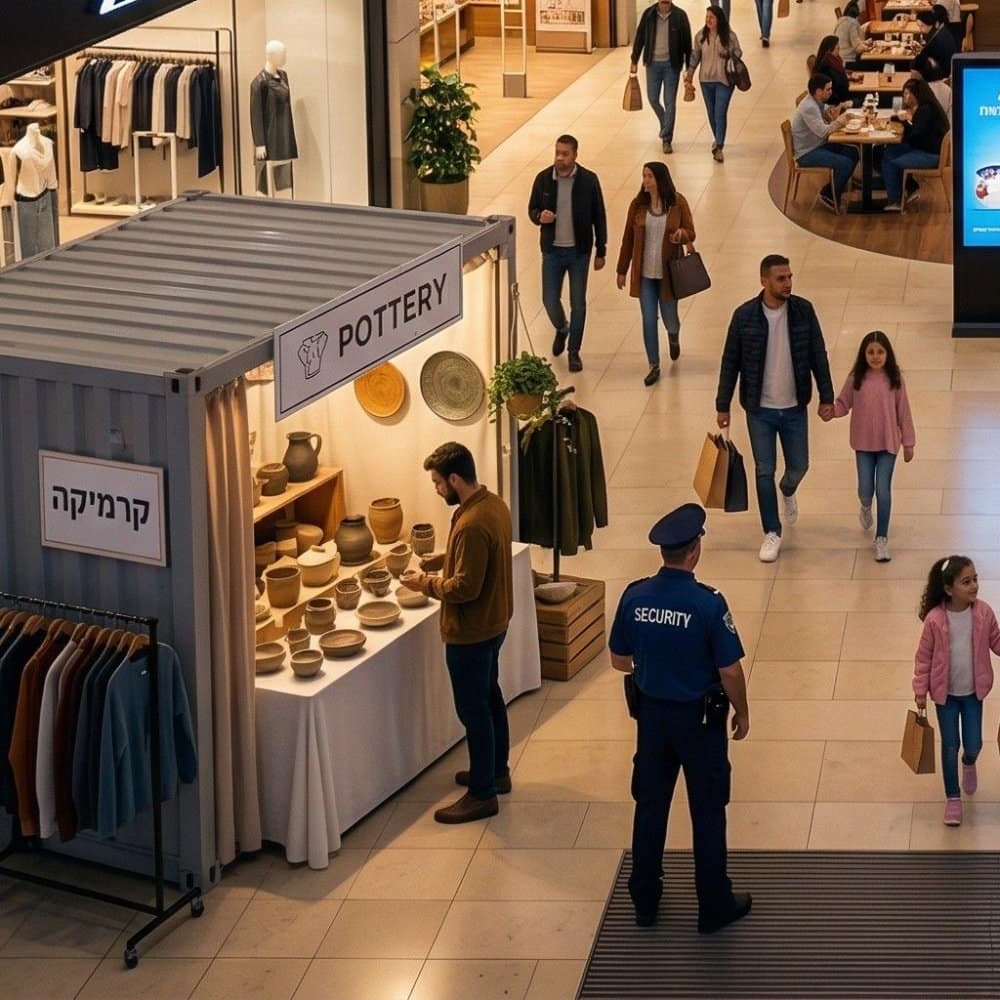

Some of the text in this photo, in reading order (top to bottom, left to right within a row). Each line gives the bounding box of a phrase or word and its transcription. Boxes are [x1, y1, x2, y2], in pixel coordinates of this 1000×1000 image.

[338, 272, 447, 358] POTTERY
[52, 485, 150, 532] קרמיקה
[634, 607, 692, 629] SECURITY
